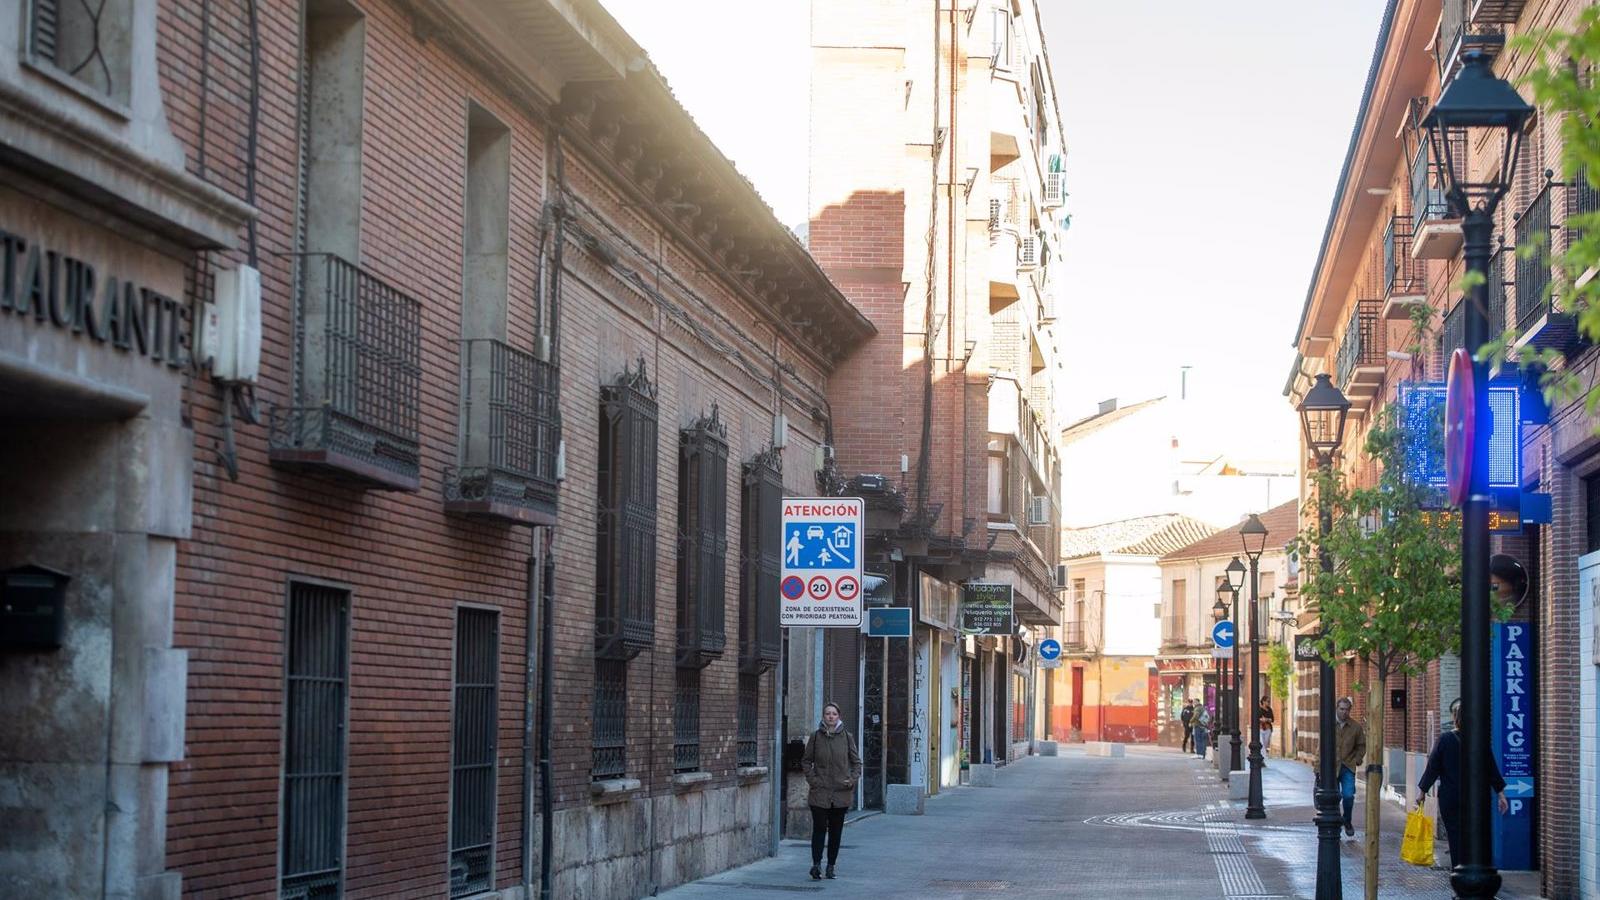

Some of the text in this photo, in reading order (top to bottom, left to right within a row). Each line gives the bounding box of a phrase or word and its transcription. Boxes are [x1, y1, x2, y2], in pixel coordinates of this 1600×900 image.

[784, 503, 858, 516] ATENCIÓN
[812, 583, 827, 592] 20
[1506, 625, 1526, 747] PARKING
[1510, 799, 1523, 815] P
